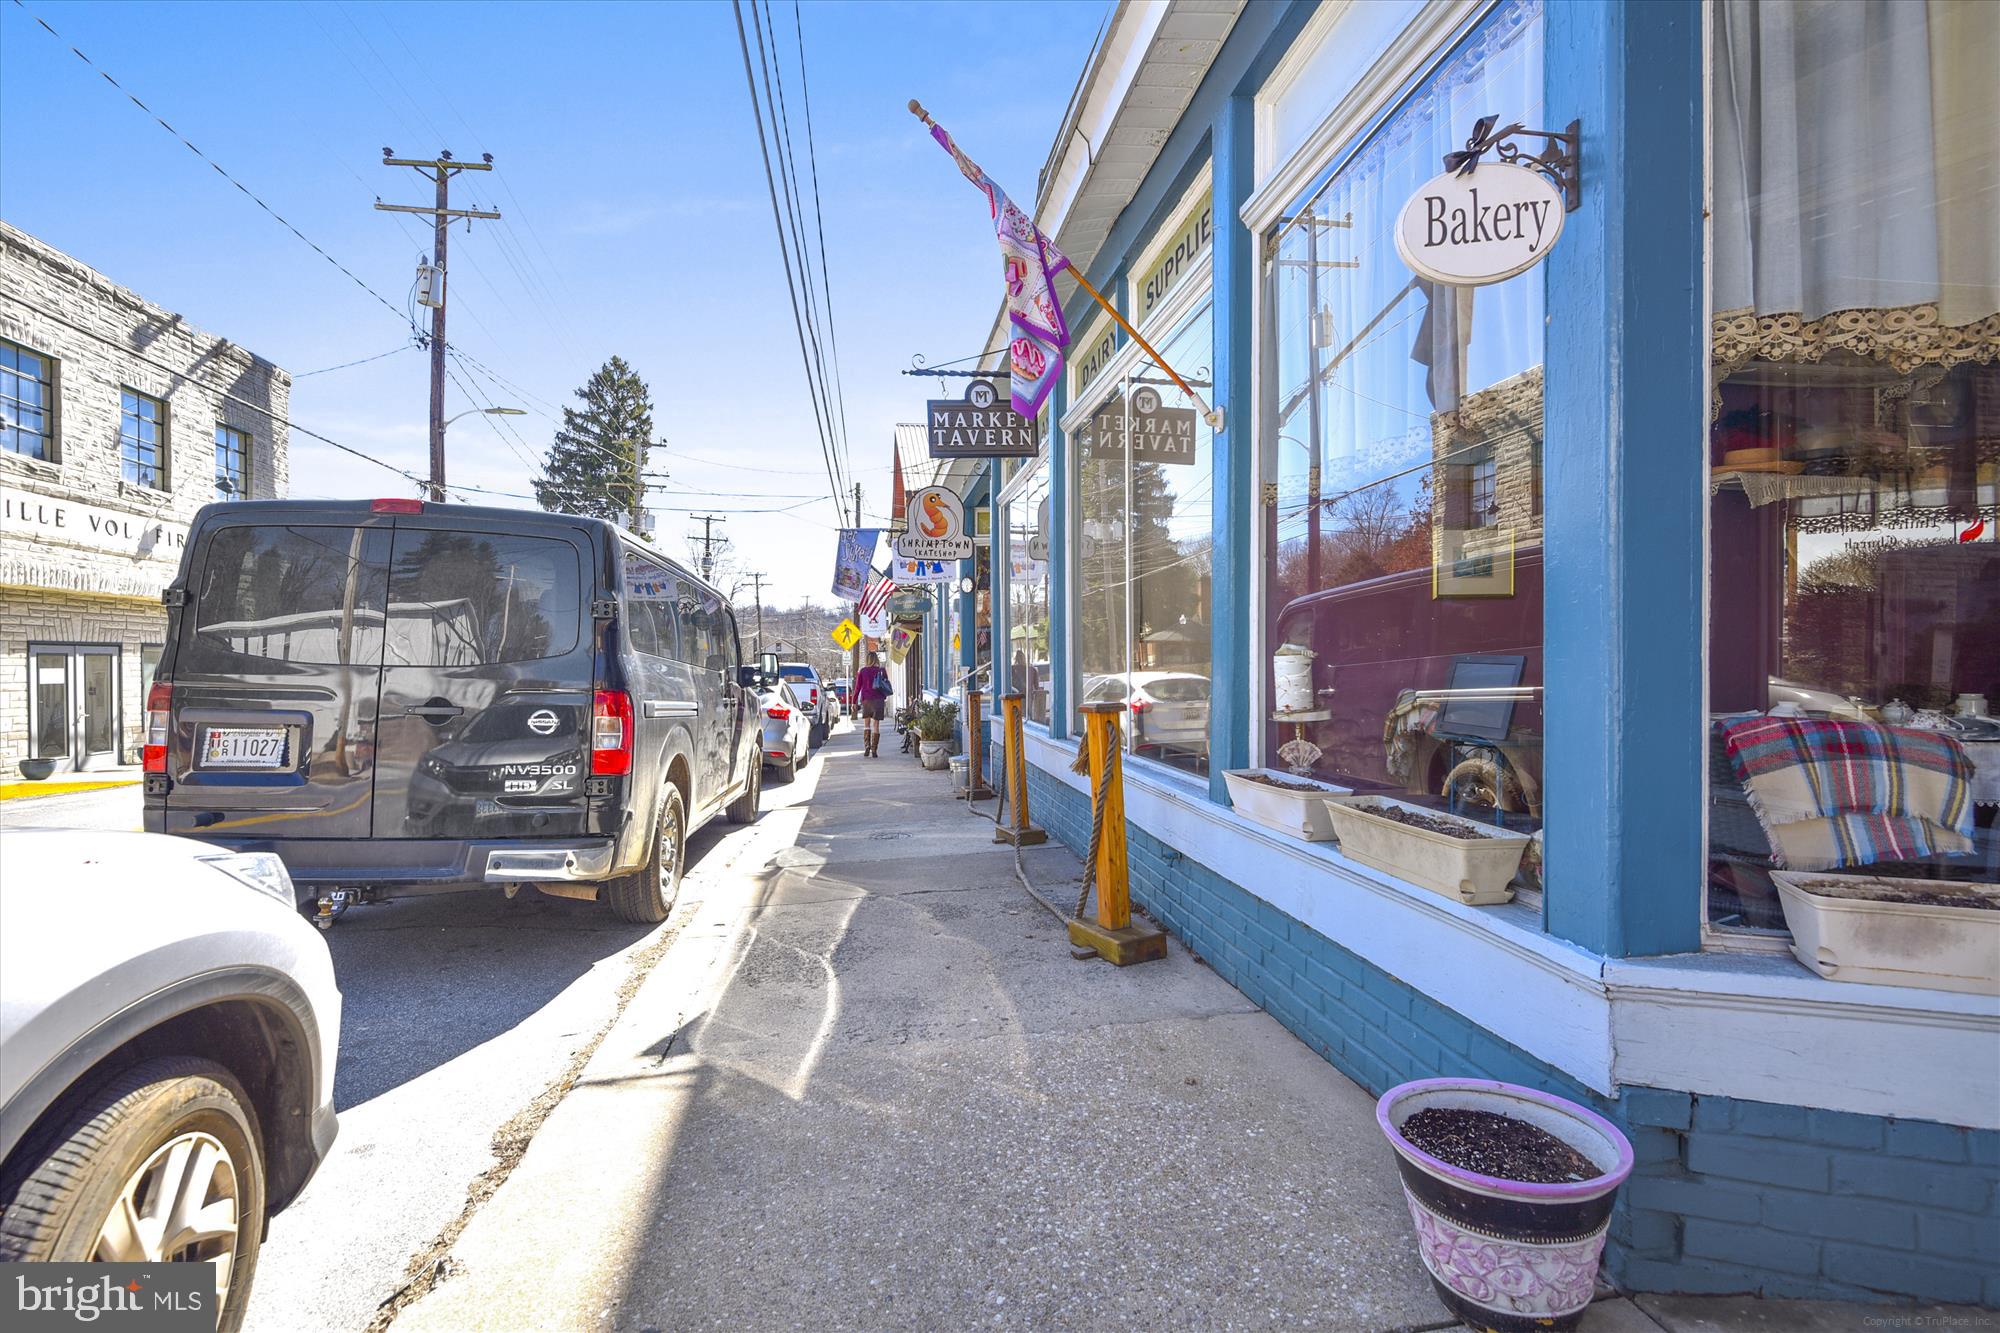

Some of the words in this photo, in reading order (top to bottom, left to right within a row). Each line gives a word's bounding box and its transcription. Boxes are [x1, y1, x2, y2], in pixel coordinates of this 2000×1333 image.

[1424, 188, 1550, 252] Bakery
[933, 428, 1033, 447] TAVERN
[6, 499, 66, 528] ILLE
[156, 528, 185, 549] FIR
[902, 538, 970, 549] SHRIMPTOWN
[914, 549, 957, 558] SKATESHOP
[233, 739, 279, 757] 11027
[505, 765, 577, 775] NV3500
[551, 780, 574, 790] SL
